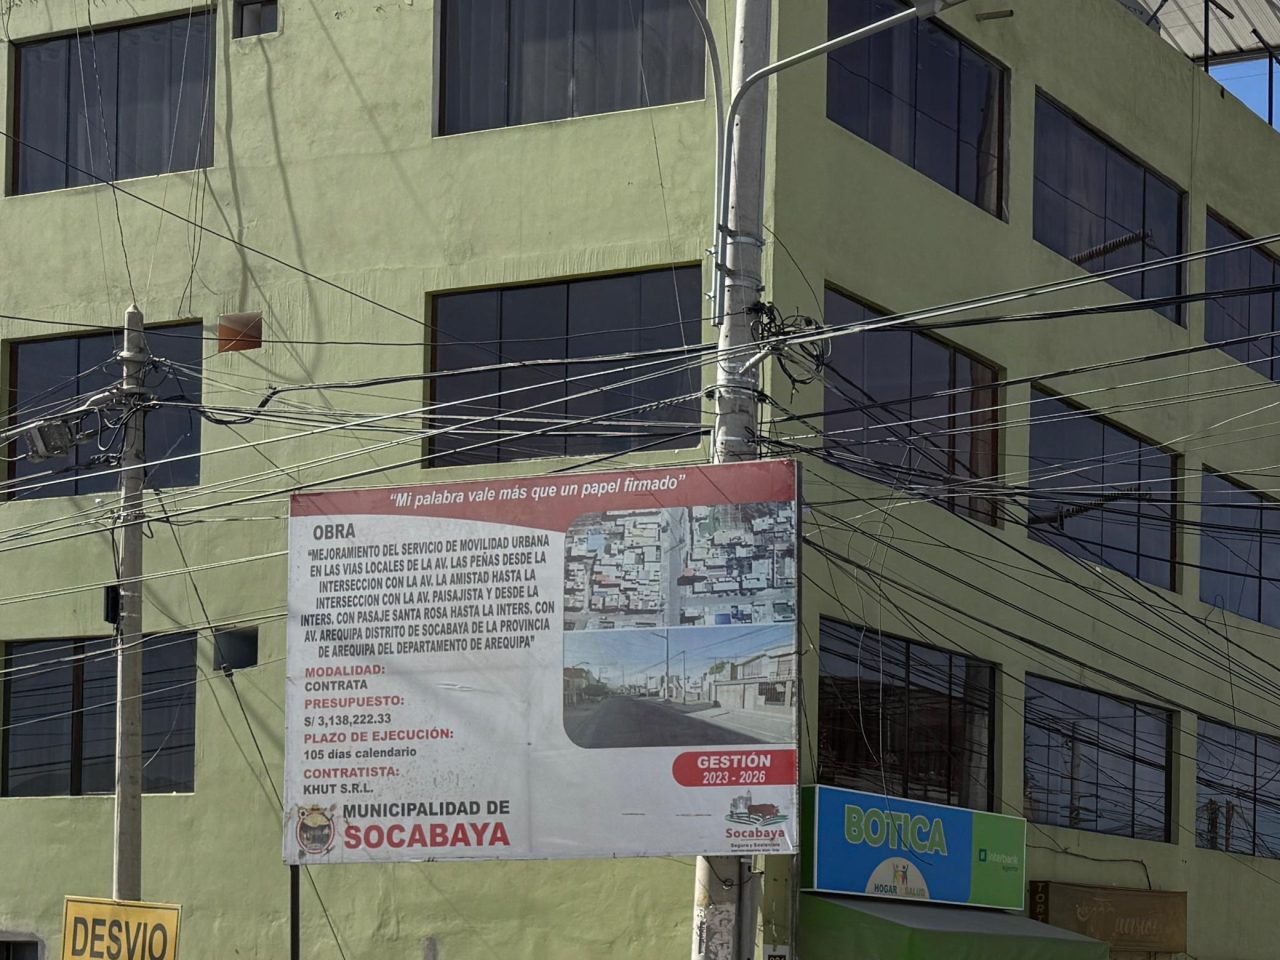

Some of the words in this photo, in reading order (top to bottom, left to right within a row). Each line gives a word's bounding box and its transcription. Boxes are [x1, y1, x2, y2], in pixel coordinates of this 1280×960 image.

[414, 490, 464, 509] palabra
[468, 488, 496, 503] vale
[499, 484, 527, 500] más
[531, 486, 557, 501] que
[560, 483, 578, 497] un
[581, 478, 621, 498] papel
[313, 523, 356, 540] OBRA
[383, 544, 399, 557] DEL
[402, 541, 443, 556] SERVICIO
[445, 540, 458, 552] DE
[460, 537, 509, 551] MOVILIDAD
[511, 534, 550, 549] URBANA
[310, 565, 322, 577] EN
[324, 563, 341, 576] LAS
[343, 562, 363, 575] VIAS
[365, 560, 405, 574] LOCALES
[407, 559, 419, 571] DE
[421, 558, 432, 571] LA
[435, 557, 448, 570] AV.
[450, 555, 468, 568] LAS
[470, 551, 500, 568] PEÑAS
[502, 552, 532, 566] DESDE
[534, 551, 546, 564] LA
[319, 577, 383, 593] INTERSECCION
[385, 576, 404, 589] CON
[406, 575, 418, 588] LA
[420, 574, 434, 587] AV.
[436, 573, 447, 586] LA
[450, 571, 489, 585] AMISTAD
[492, 569, 522, 583] HASTA
[524, 569, 536, 581] LA
[316, 594, 380, 609] INTERSECCION
[382, 592, 400, 605] CON
[403, 591, 414, 604] LA
[416, 591, 430, 604] AV.
[433, 588, 484, 603] PAISAJISTA
[486, 587, 493, 600] Y
[495, 586, 525, 600] DESDE
[527, 585, 539, 598] LA
[301, 613, 334, 627] INTERS.
[336, 611, 355, 624] CON
[357, 609, 390, 623] PASAJE
[392, 608, 421, 622] SANTA
[424, 606, 448, 620] ROSA
[450, 604, 480, 618] HASTA
[482, 604, 494, 617] LA
[496, 602, 532, 616] INTERS.
[535, 601, 555, 614] CON
[304, 630, 317, 643] AV.
[319, 627, 363, 642] AREQUIPA
[365, 625, 406, 639] DISTRITO
[408, 624, 420, 637] DE
[422, 621, 469, 636] SOCABAYA
[471, 621, 484, 634] DE
[486, 620, 498, 633] LA
[500, 617, 550, 633] PROVINCIA
[318, 646, 330, 658] DE
[331, 643, 375, 657] AREQUIPA
[378, 642, 394, 655] DEL
[397, 638, 468, 654] DEPARTAMENTO
[470, 637, 482, 650] DE
[305, 664, 385, 678] MODALIDAD:
[304, 680, 368, 692] CONTRATA
[304, 695, 404, 709] PRESUPUESTO:
[318, 713, 391, 728] 3,138,222.33
[304, 732, 346, 744] PLAZO
[351, 731, 368, 742] DE
[372, 727, 453, 741] EJECUCIÓN:
[304, 750, 324, 760] 105
[328, 748, 352, 760] días
[355, 746, 417, 759] calendario
[697, 752, 771, 769] GESTIÓN
[304, 767, 400, 779] CONTRATISTA:
[703, 772, 729, 784] 2023
[740, 771, 766, 783] 2026
[304, 784, 337, 795] KHUT
[340, 783, 374, 794] S.R.L.
[343, 801, 480, 819] MUNICIPALIDAD
[487, 800, 510, 815] DE
[344, 822, 510, 849] SOCABAYA
[726, 827, 785, 842] Socabaya
[844, 804, 947, 856] BOTICA
[874, 883, 897, 895] HOGAR
